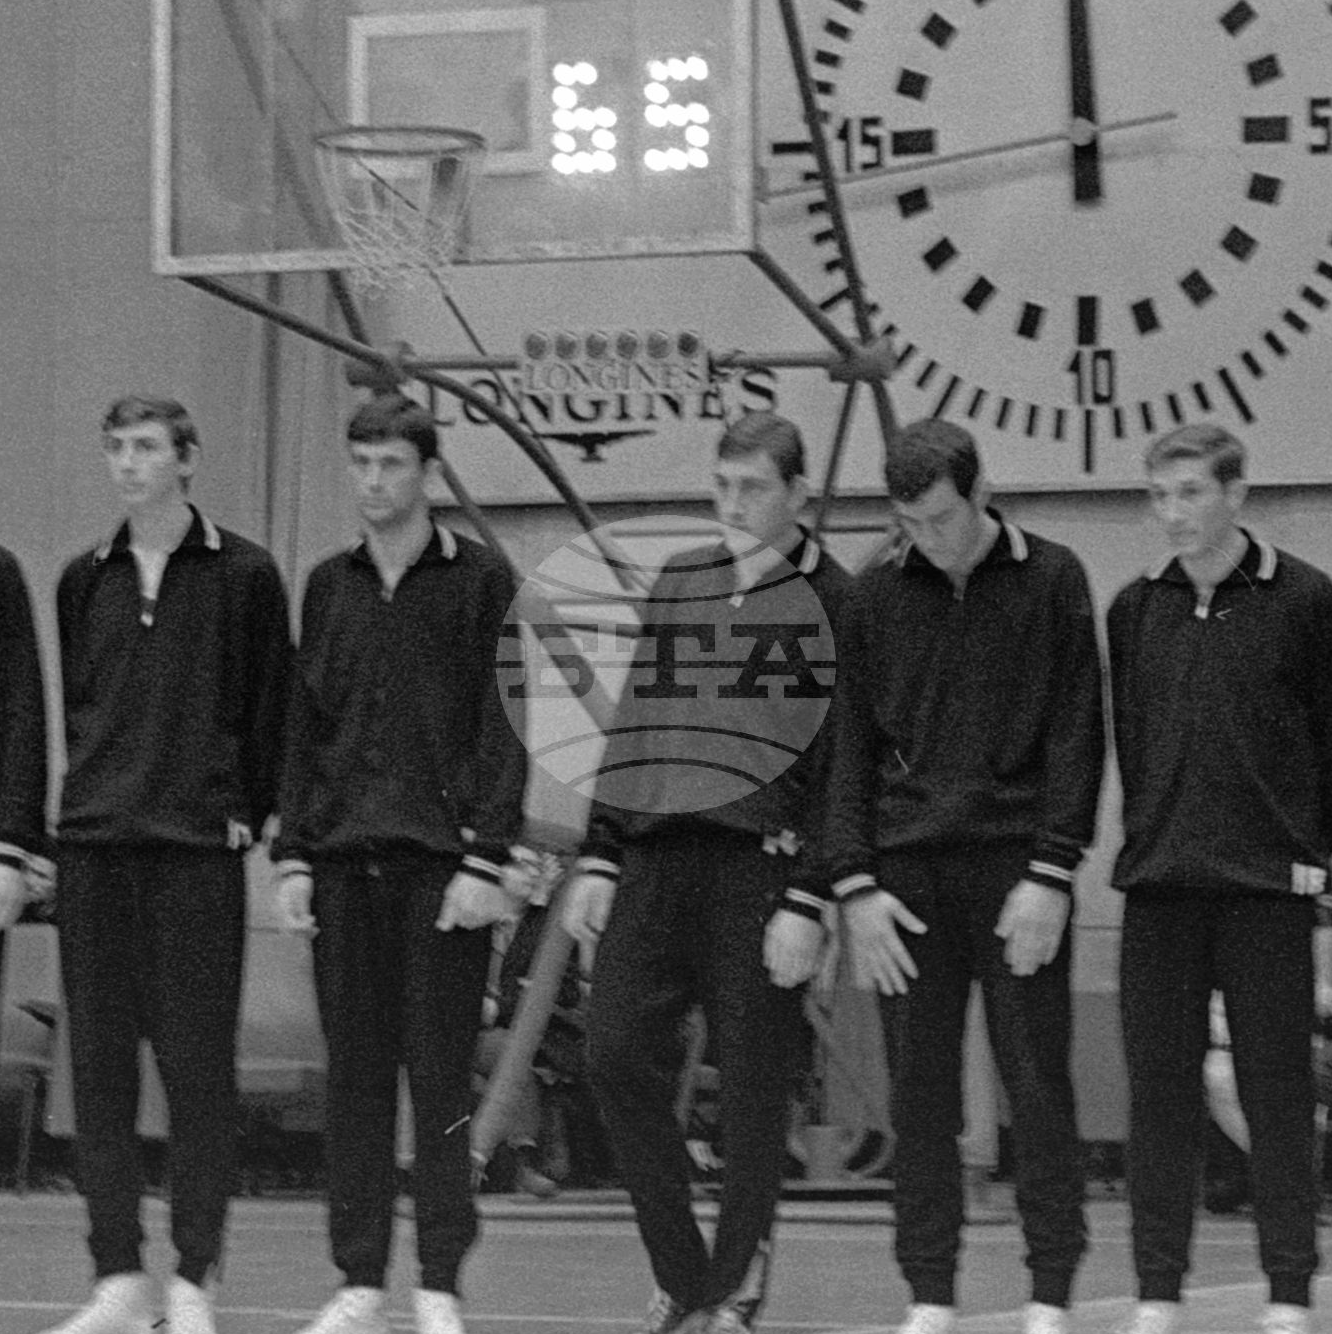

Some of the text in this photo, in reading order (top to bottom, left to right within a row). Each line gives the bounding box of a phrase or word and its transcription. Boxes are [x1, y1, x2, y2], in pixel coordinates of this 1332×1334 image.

[552, 56, 710, 175] 65
[1309, 97, 1332, 154] 5
[836, 117, 882, 172] 15
[527, 363, 701, 391] LONGINES
[1067, 348, 1115, 405] 10
